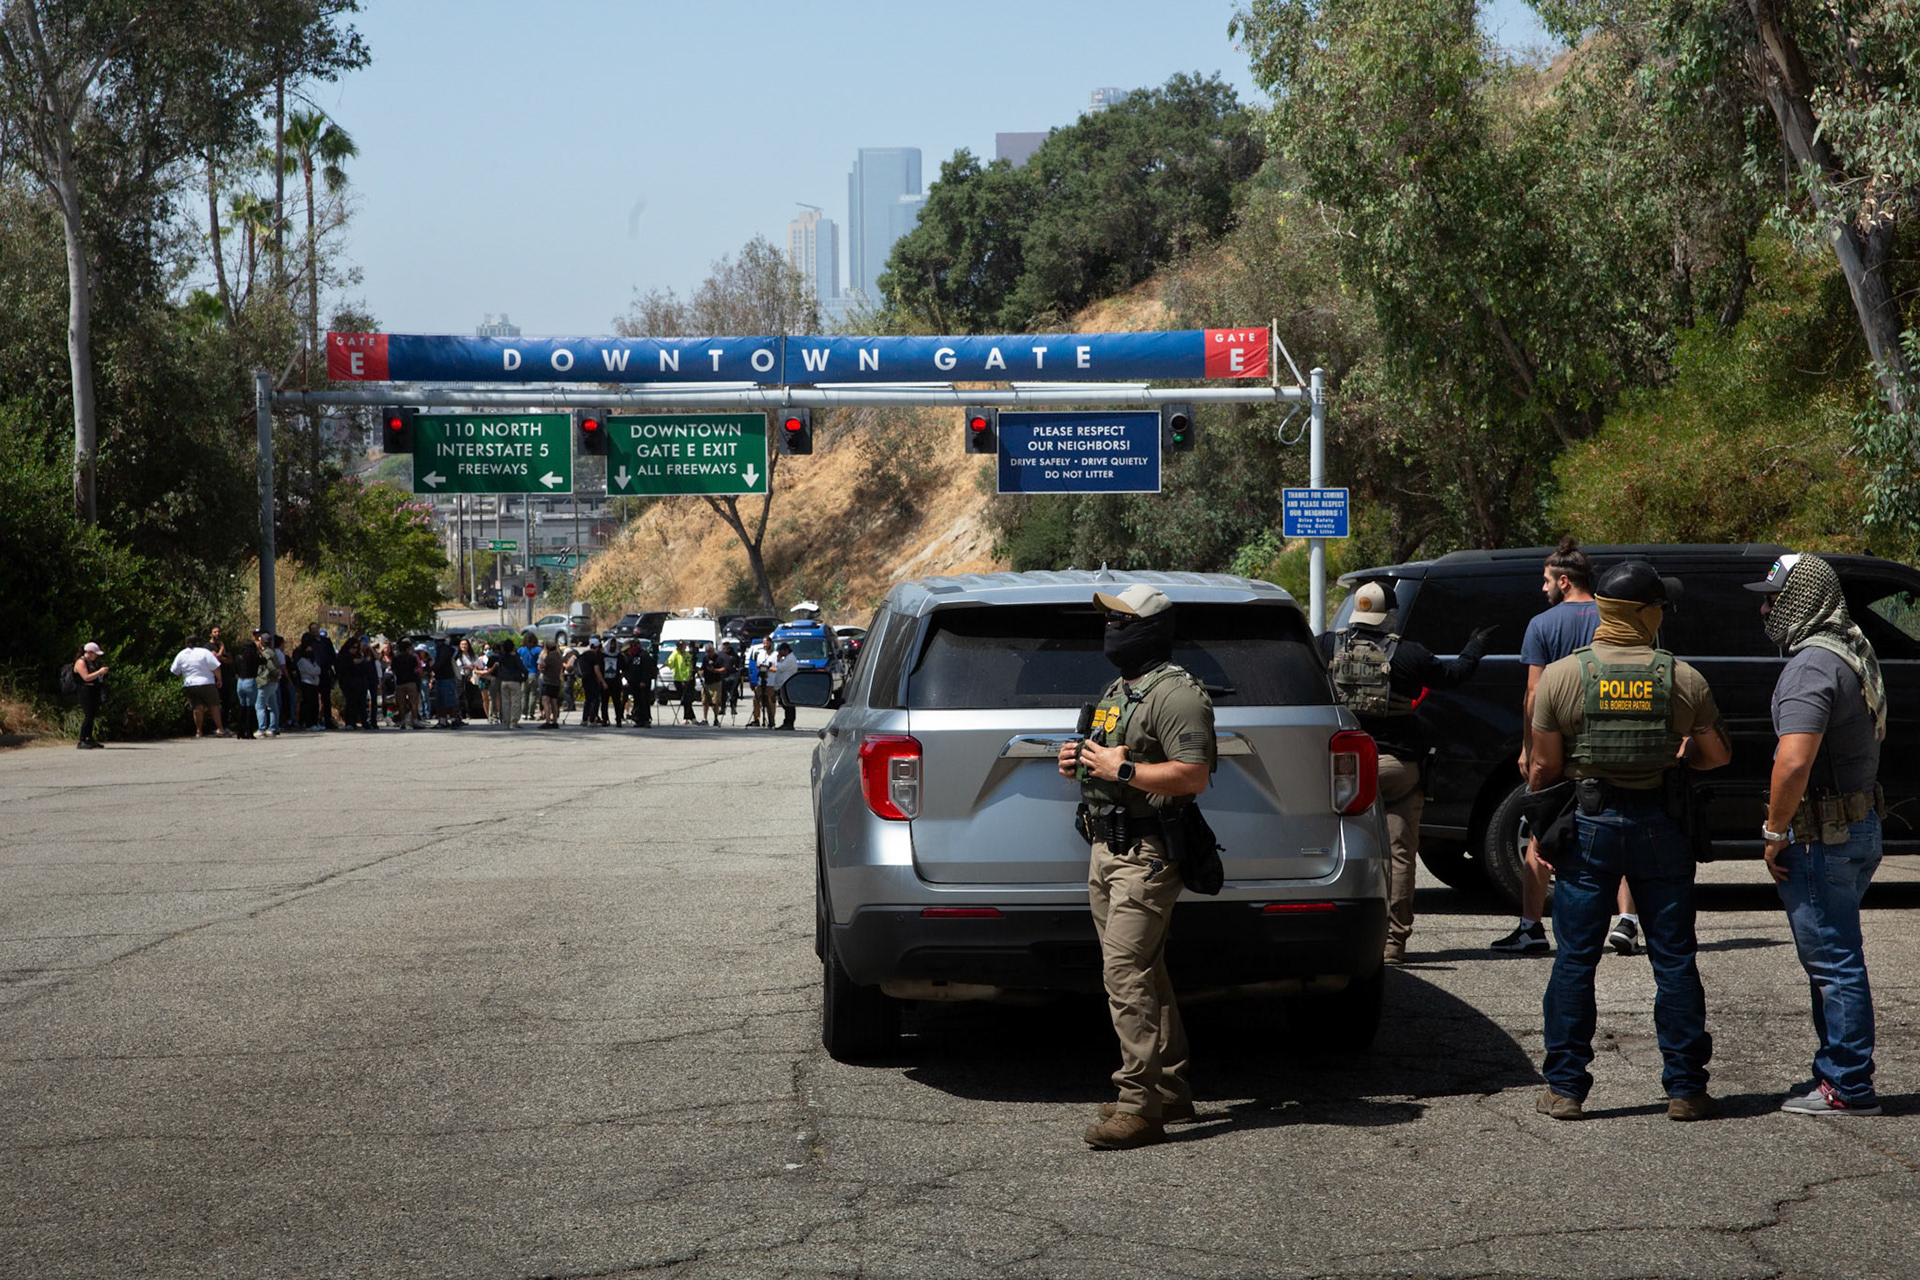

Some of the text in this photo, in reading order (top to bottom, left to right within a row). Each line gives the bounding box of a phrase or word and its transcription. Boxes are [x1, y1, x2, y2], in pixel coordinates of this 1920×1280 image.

[336, 336, 374, 346] GATE
[1214, 332, 1255, 342] GATE
[350, 352, 364, 374] E
[503, 346, 1091, 372] DOWNTOWN GATE
[1230, 348, 1244, 371] E
[444, 422, 542, 437] 110 NORTH
[630, 423, 742, 438] DOWNTOWN
[1033, 426, 1126, 436] PLEASE RESPECT
[436, 443, 549, 458] INTERSTATE 5
[636, 442, 738, 458] GATE E EXIT
[1028, 440, 1130, 451] OUR NEIGHBORS!
[1010, 457, 1148, 466] DRIVE SAFELY DRIVE QUIETLY
[458, 463, 528, 475] FREEWAYS
[637, 462, 737, 476] ALL FREEWAYS
[1044, 470, 1114, 479] DO NOT LITTER
[1600, 680, 1653, 698] POLICE
[1600, 700, 1652, 711] U.S. BORDER PATROL
